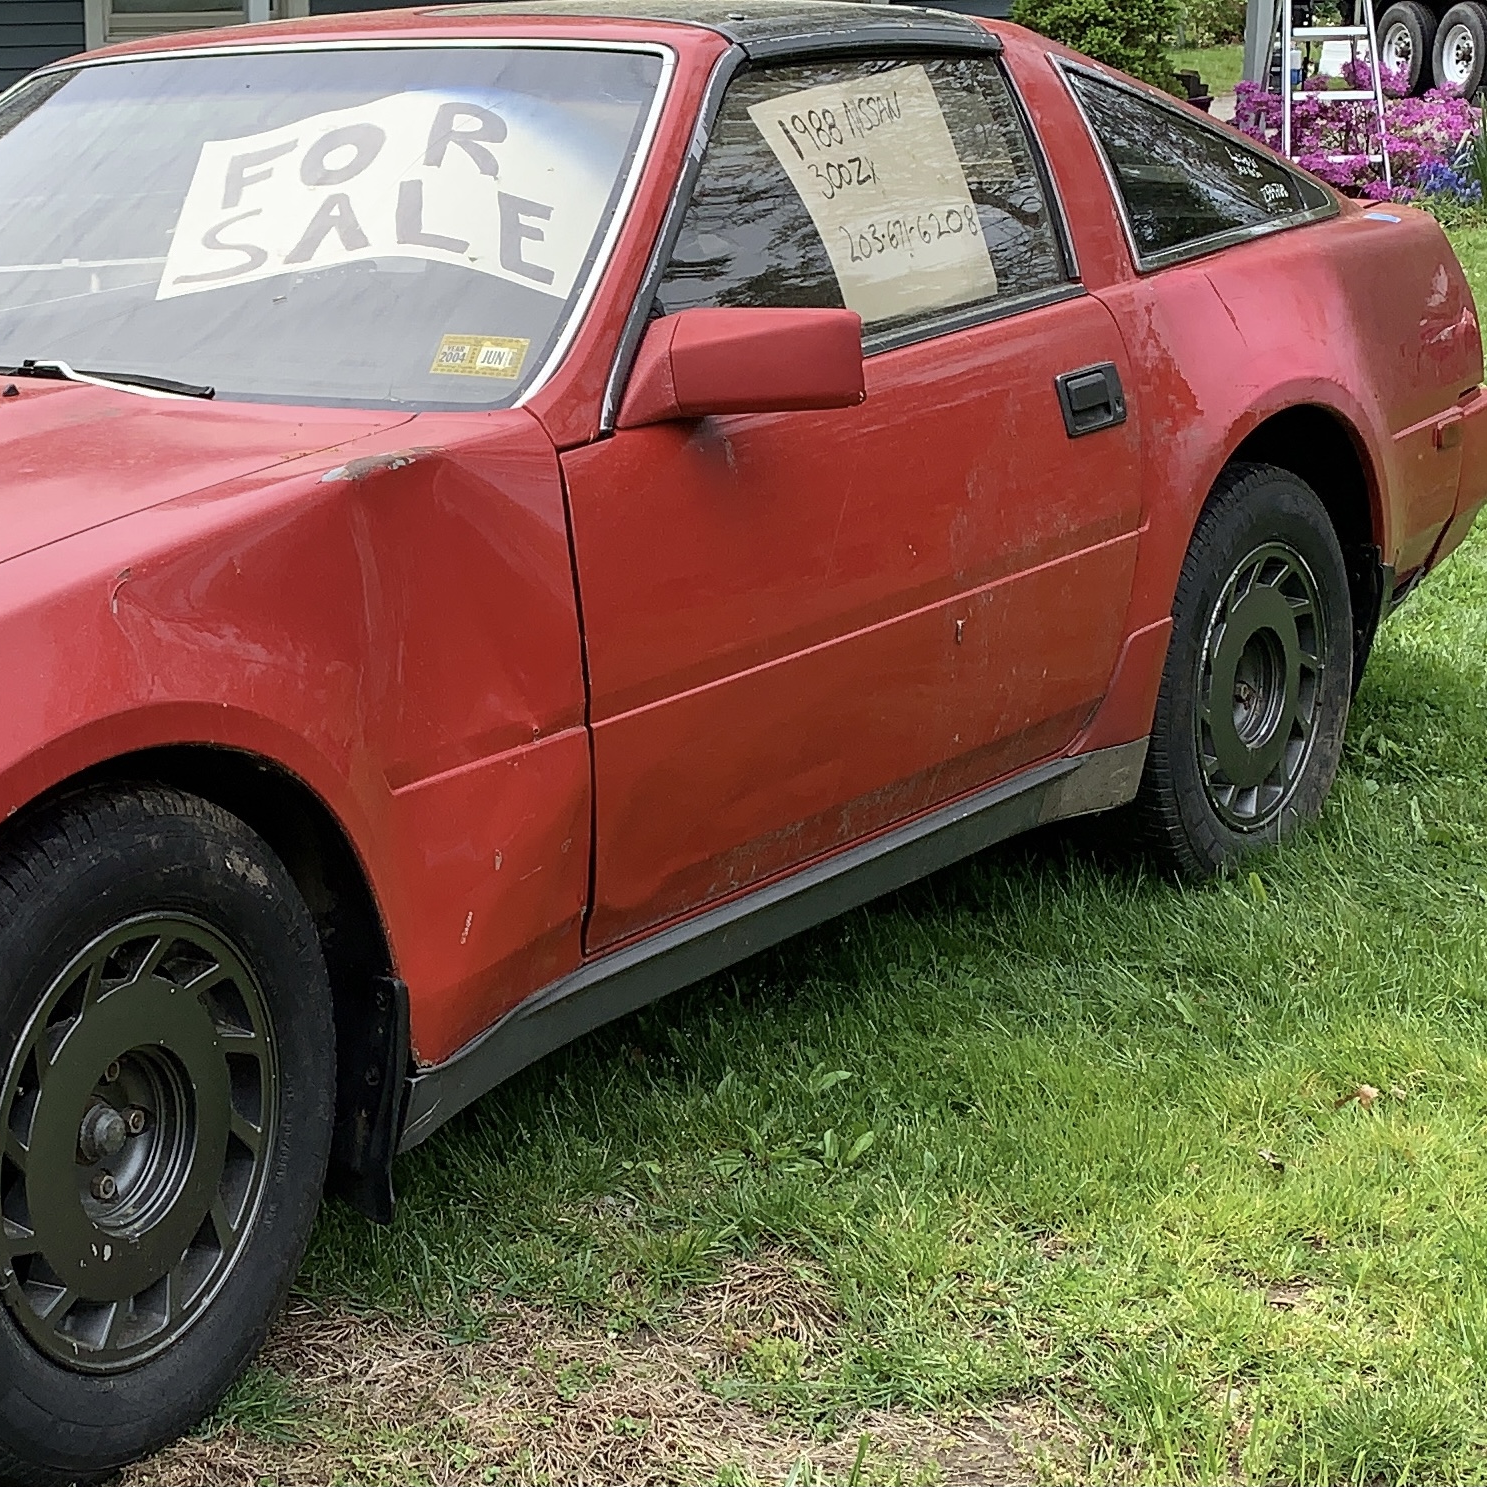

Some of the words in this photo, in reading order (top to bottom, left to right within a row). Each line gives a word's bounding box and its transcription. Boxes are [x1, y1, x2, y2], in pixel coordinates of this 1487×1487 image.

[220, 101, 508, 208] FOR
[777, 108, 844, 161] 1988
[842, 90, 901, 139] NISSAN
[172, 179, 555, 286] SALE
[438, 351, 468, 364] 2004
[480, 349, 506, 366] JUN
